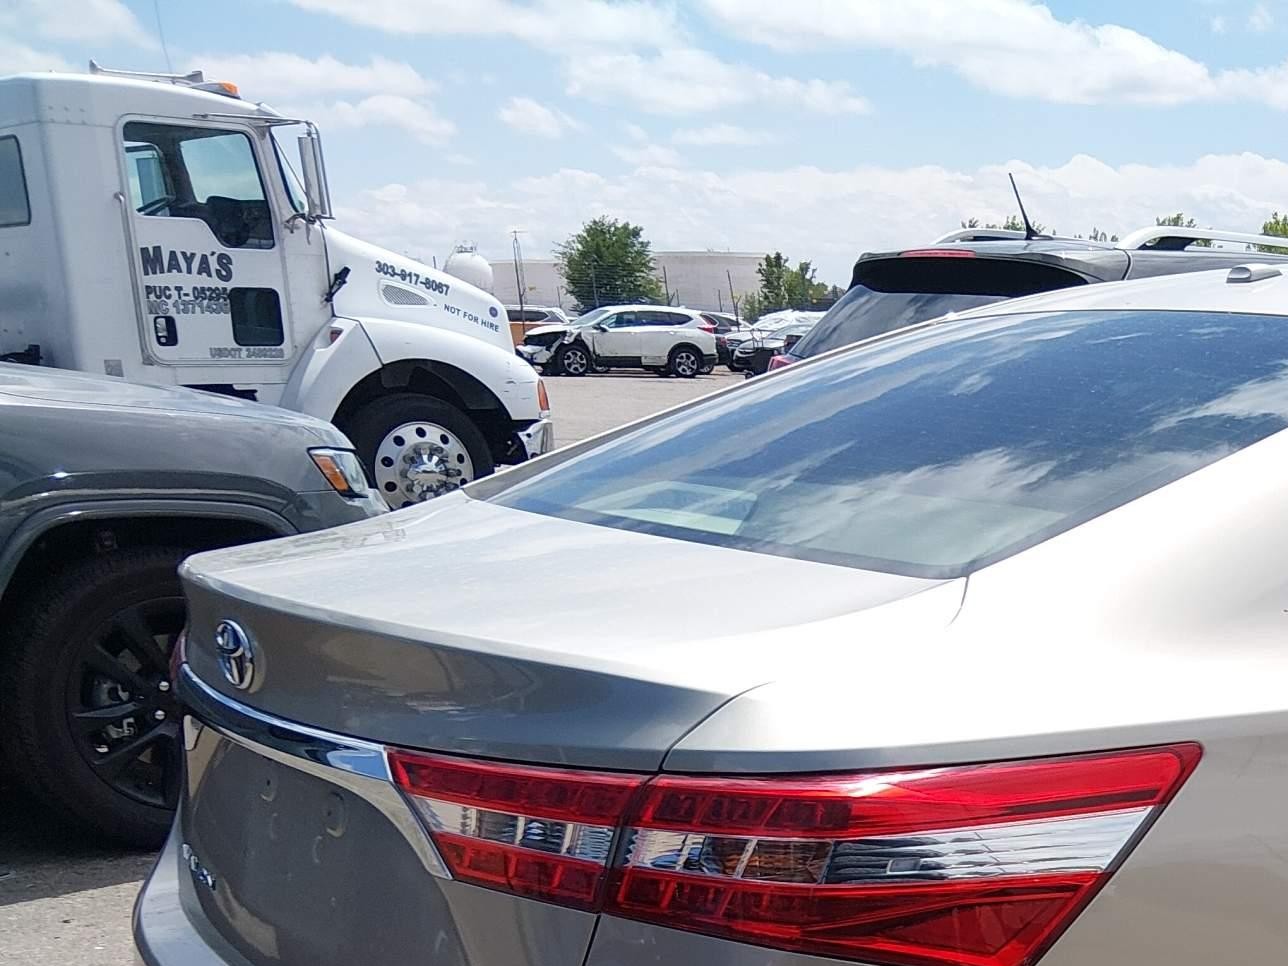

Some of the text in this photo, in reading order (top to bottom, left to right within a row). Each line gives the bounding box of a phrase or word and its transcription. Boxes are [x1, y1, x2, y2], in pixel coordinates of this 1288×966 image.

[145, 285, 172, 300] PUC
[444, 303, 499, 333] NOT FOR HIRE
